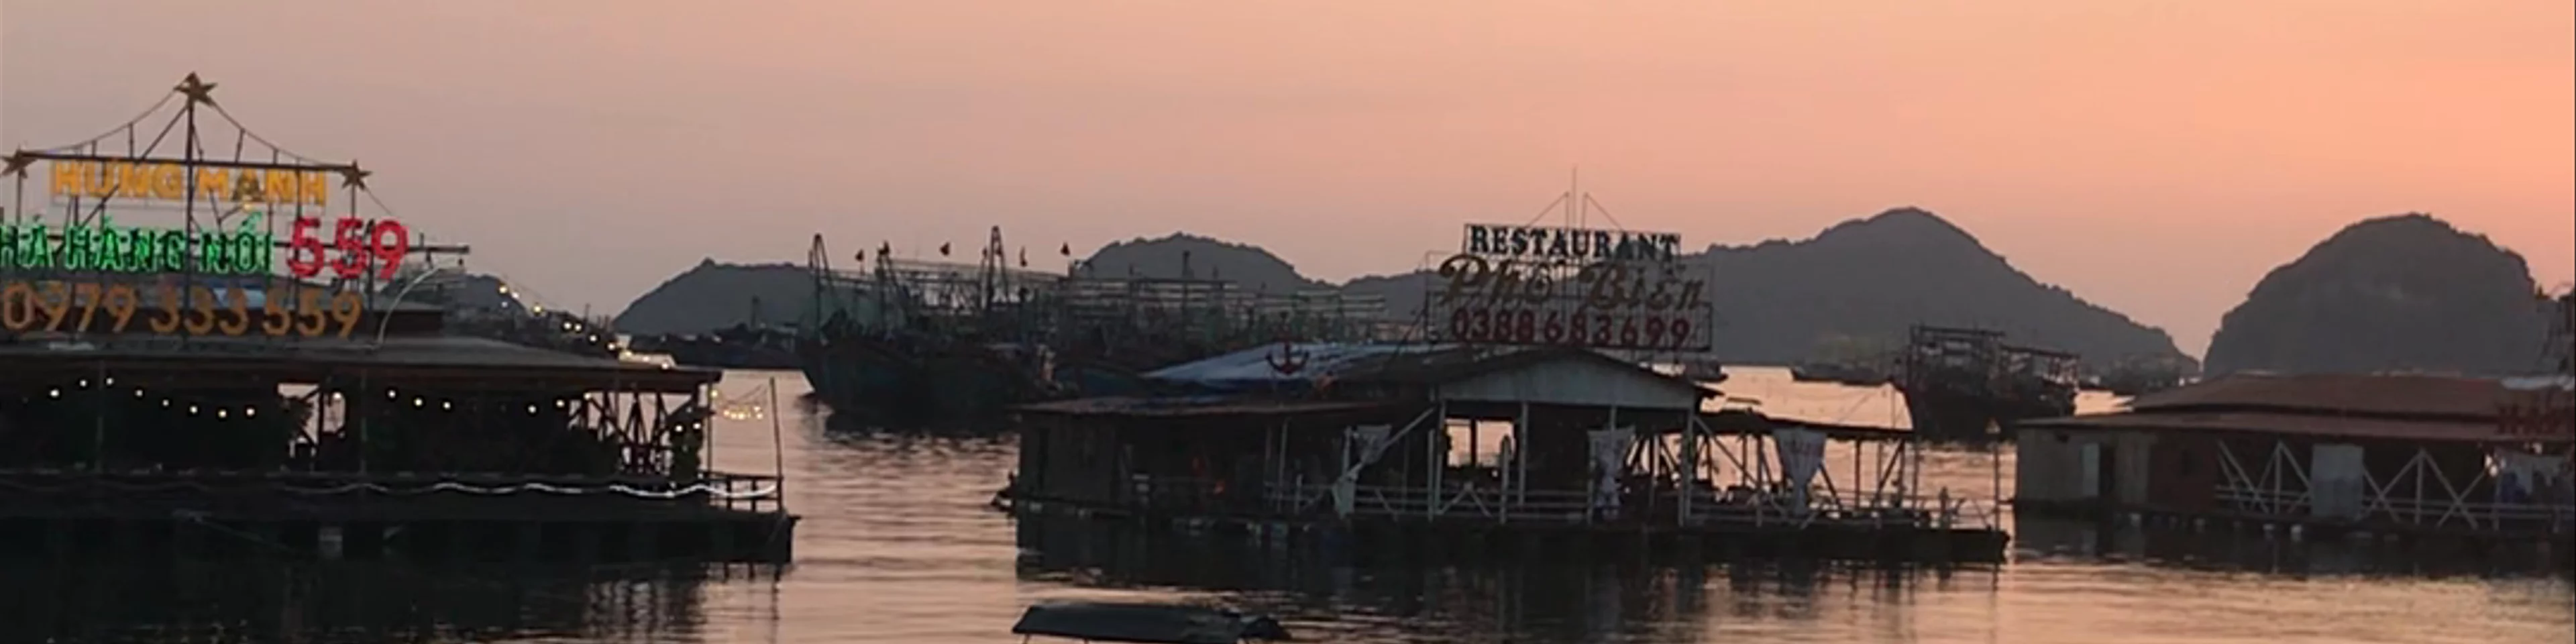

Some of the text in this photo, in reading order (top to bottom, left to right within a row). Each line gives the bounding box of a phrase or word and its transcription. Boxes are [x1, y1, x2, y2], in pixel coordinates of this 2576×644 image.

[286, 217, 409, 282] 559
[1470, 225, 1680, 262] RESTAURANT
[2, 281, 138, 333] 0979
[262, 287, 363, 339] 559
